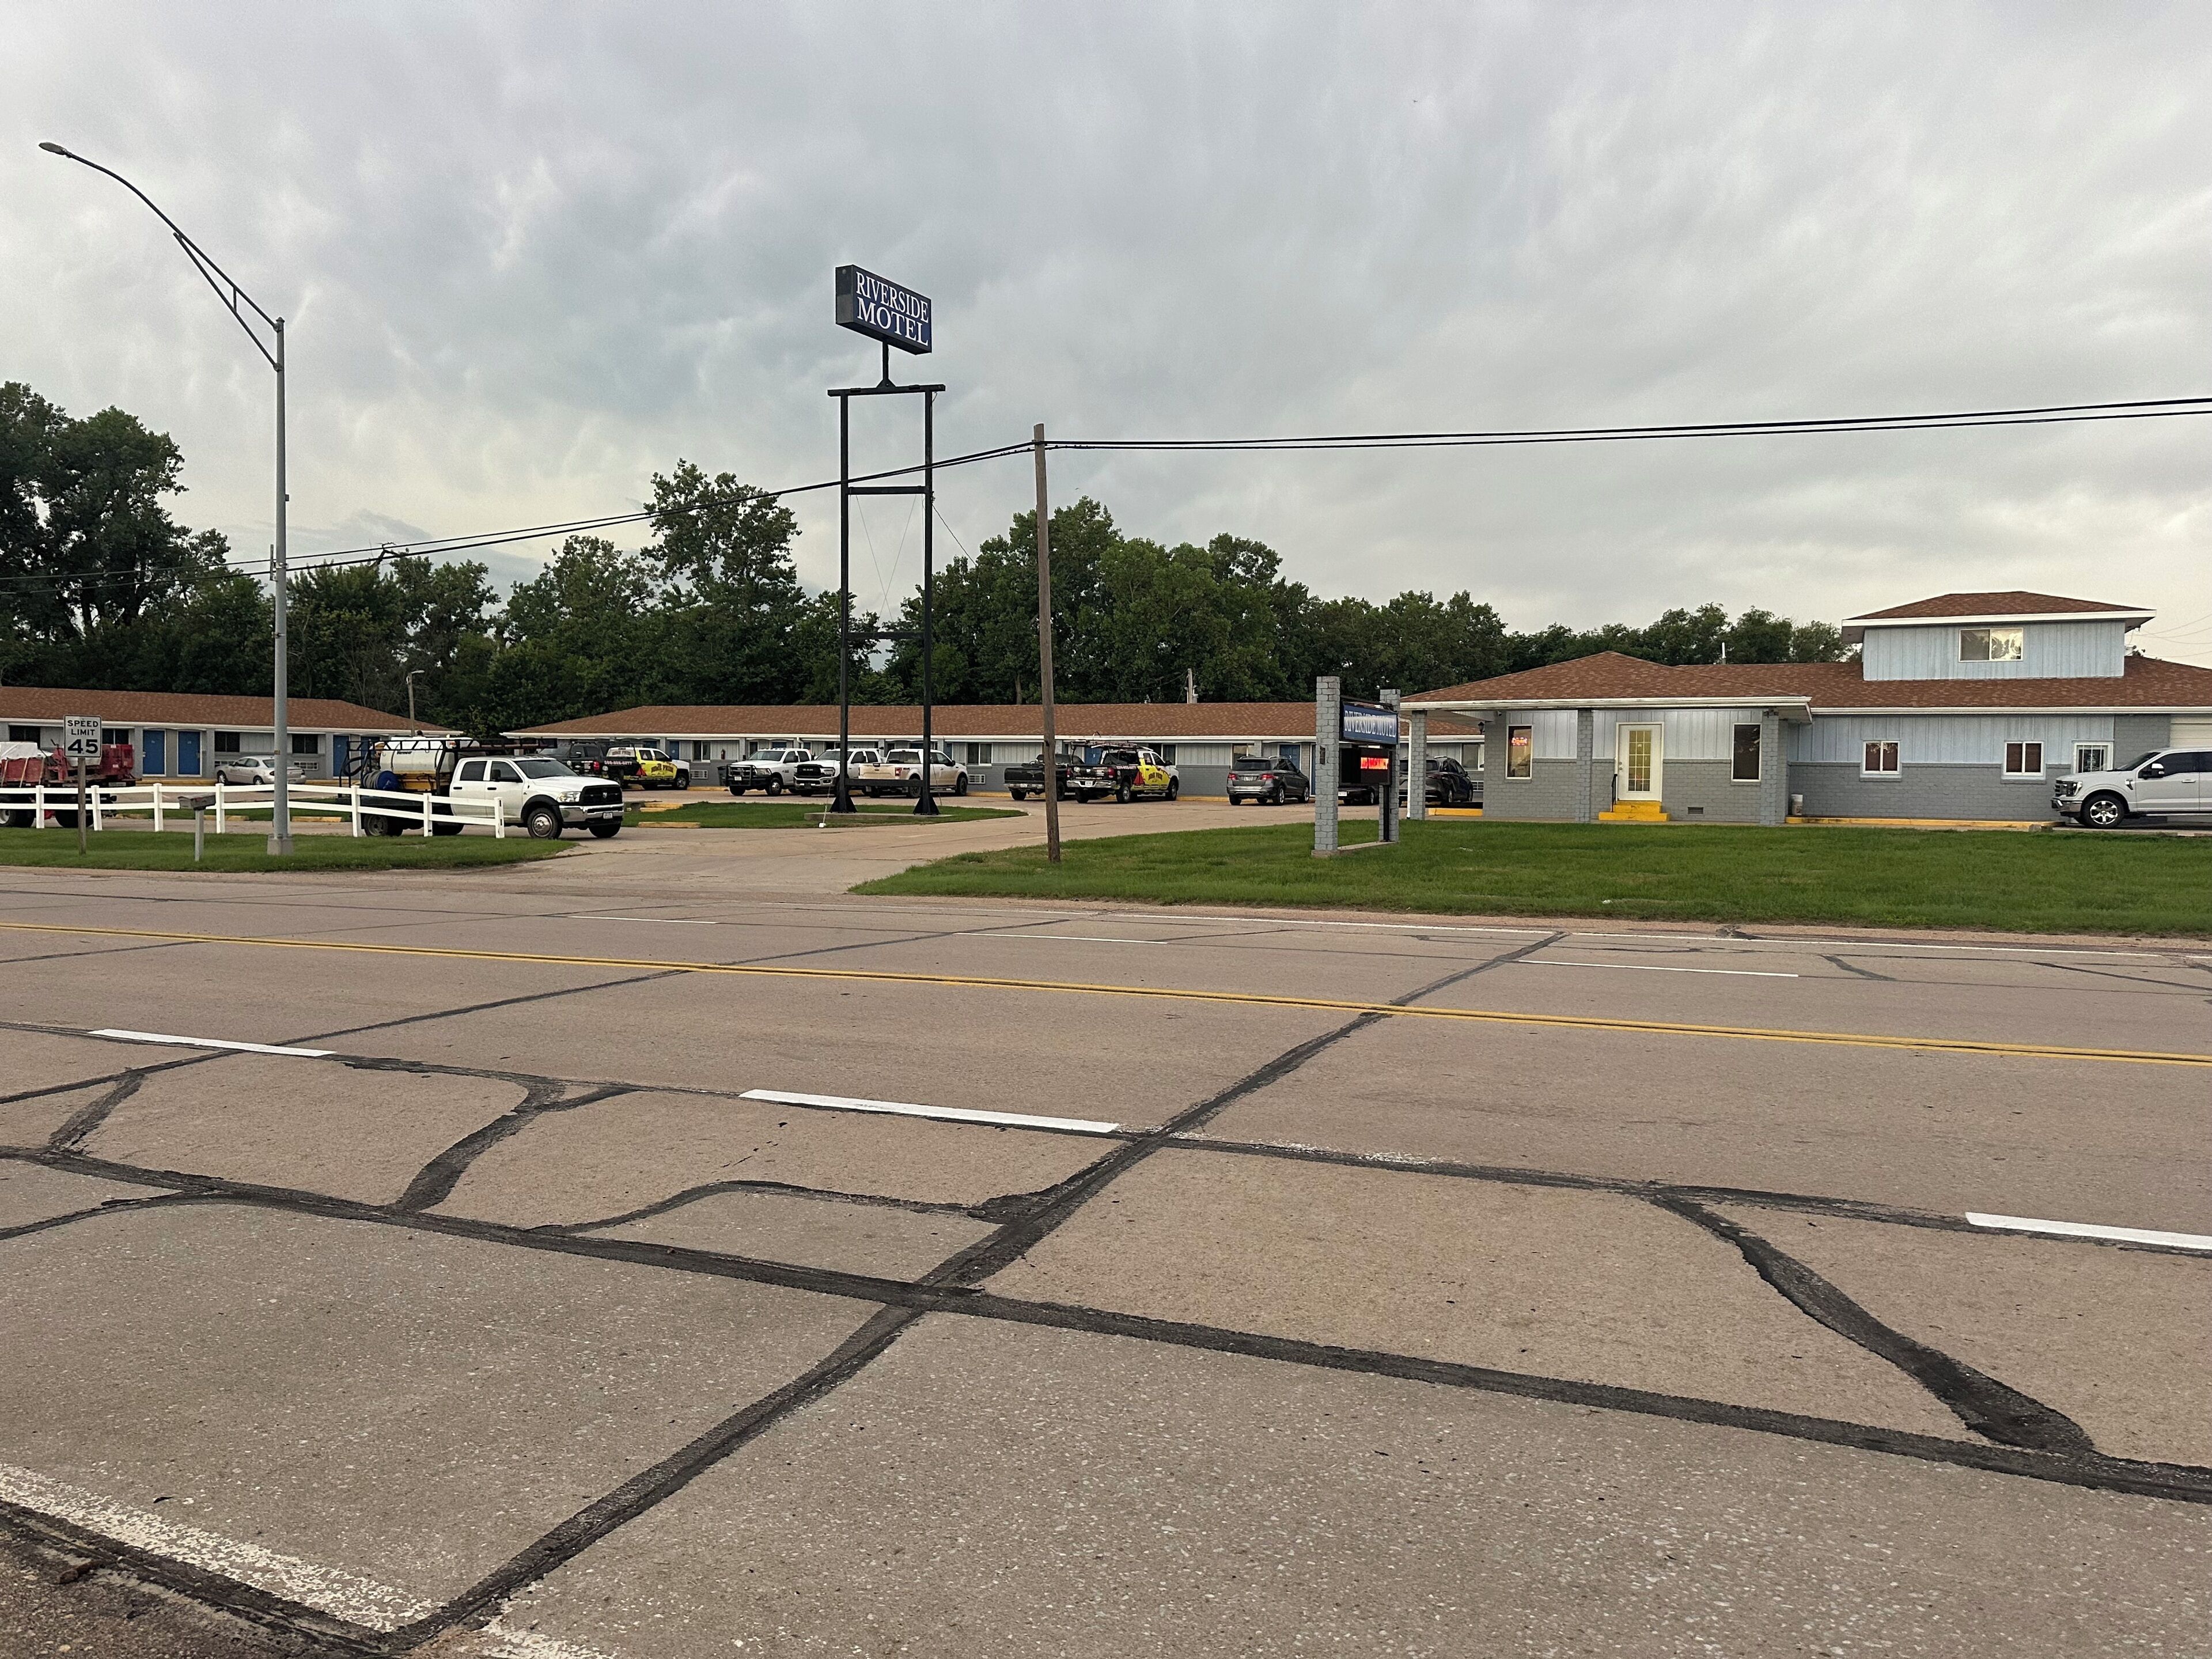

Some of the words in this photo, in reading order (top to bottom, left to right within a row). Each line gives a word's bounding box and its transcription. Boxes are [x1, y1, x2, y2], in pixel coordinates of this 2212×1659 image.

[856, 271, 929, 323] RIVERSIDE
[857, 297, 929, 346] MOTEL
[1344, 710, 1376, 735] RIVERSIDE
[1376, 715, 1396, 737] MOTEL
[67, 738, 99, 754] 45
